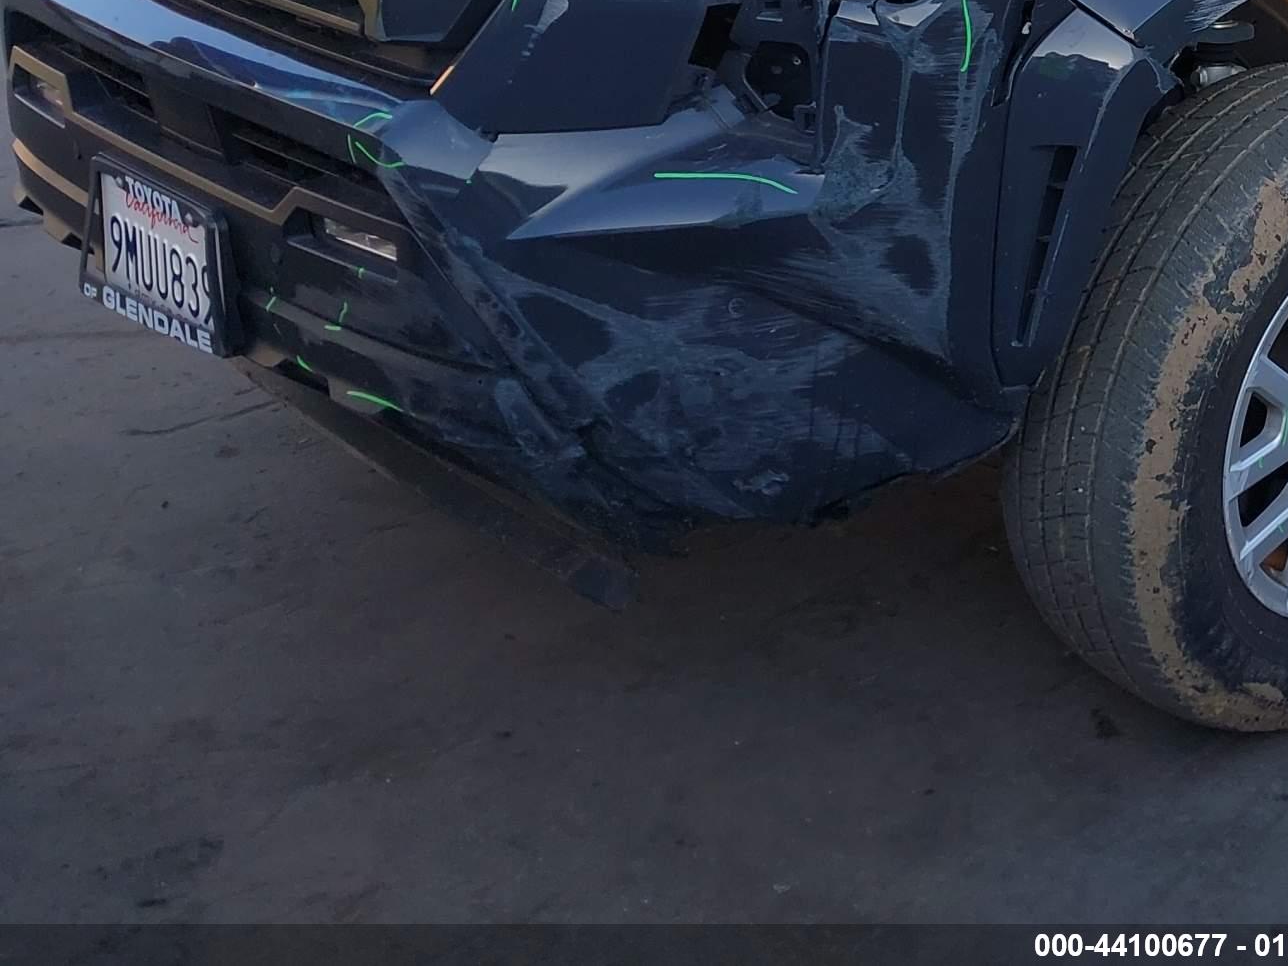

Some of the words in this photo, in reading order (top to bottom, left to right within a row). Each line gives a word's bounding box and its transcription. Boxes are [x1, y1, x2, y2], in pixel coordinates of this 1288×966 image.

[125, 175, 183, 225] TOYOTA
[83, 283, 98, 300] OF
[103, 286, 213, 354] GLENDALE
